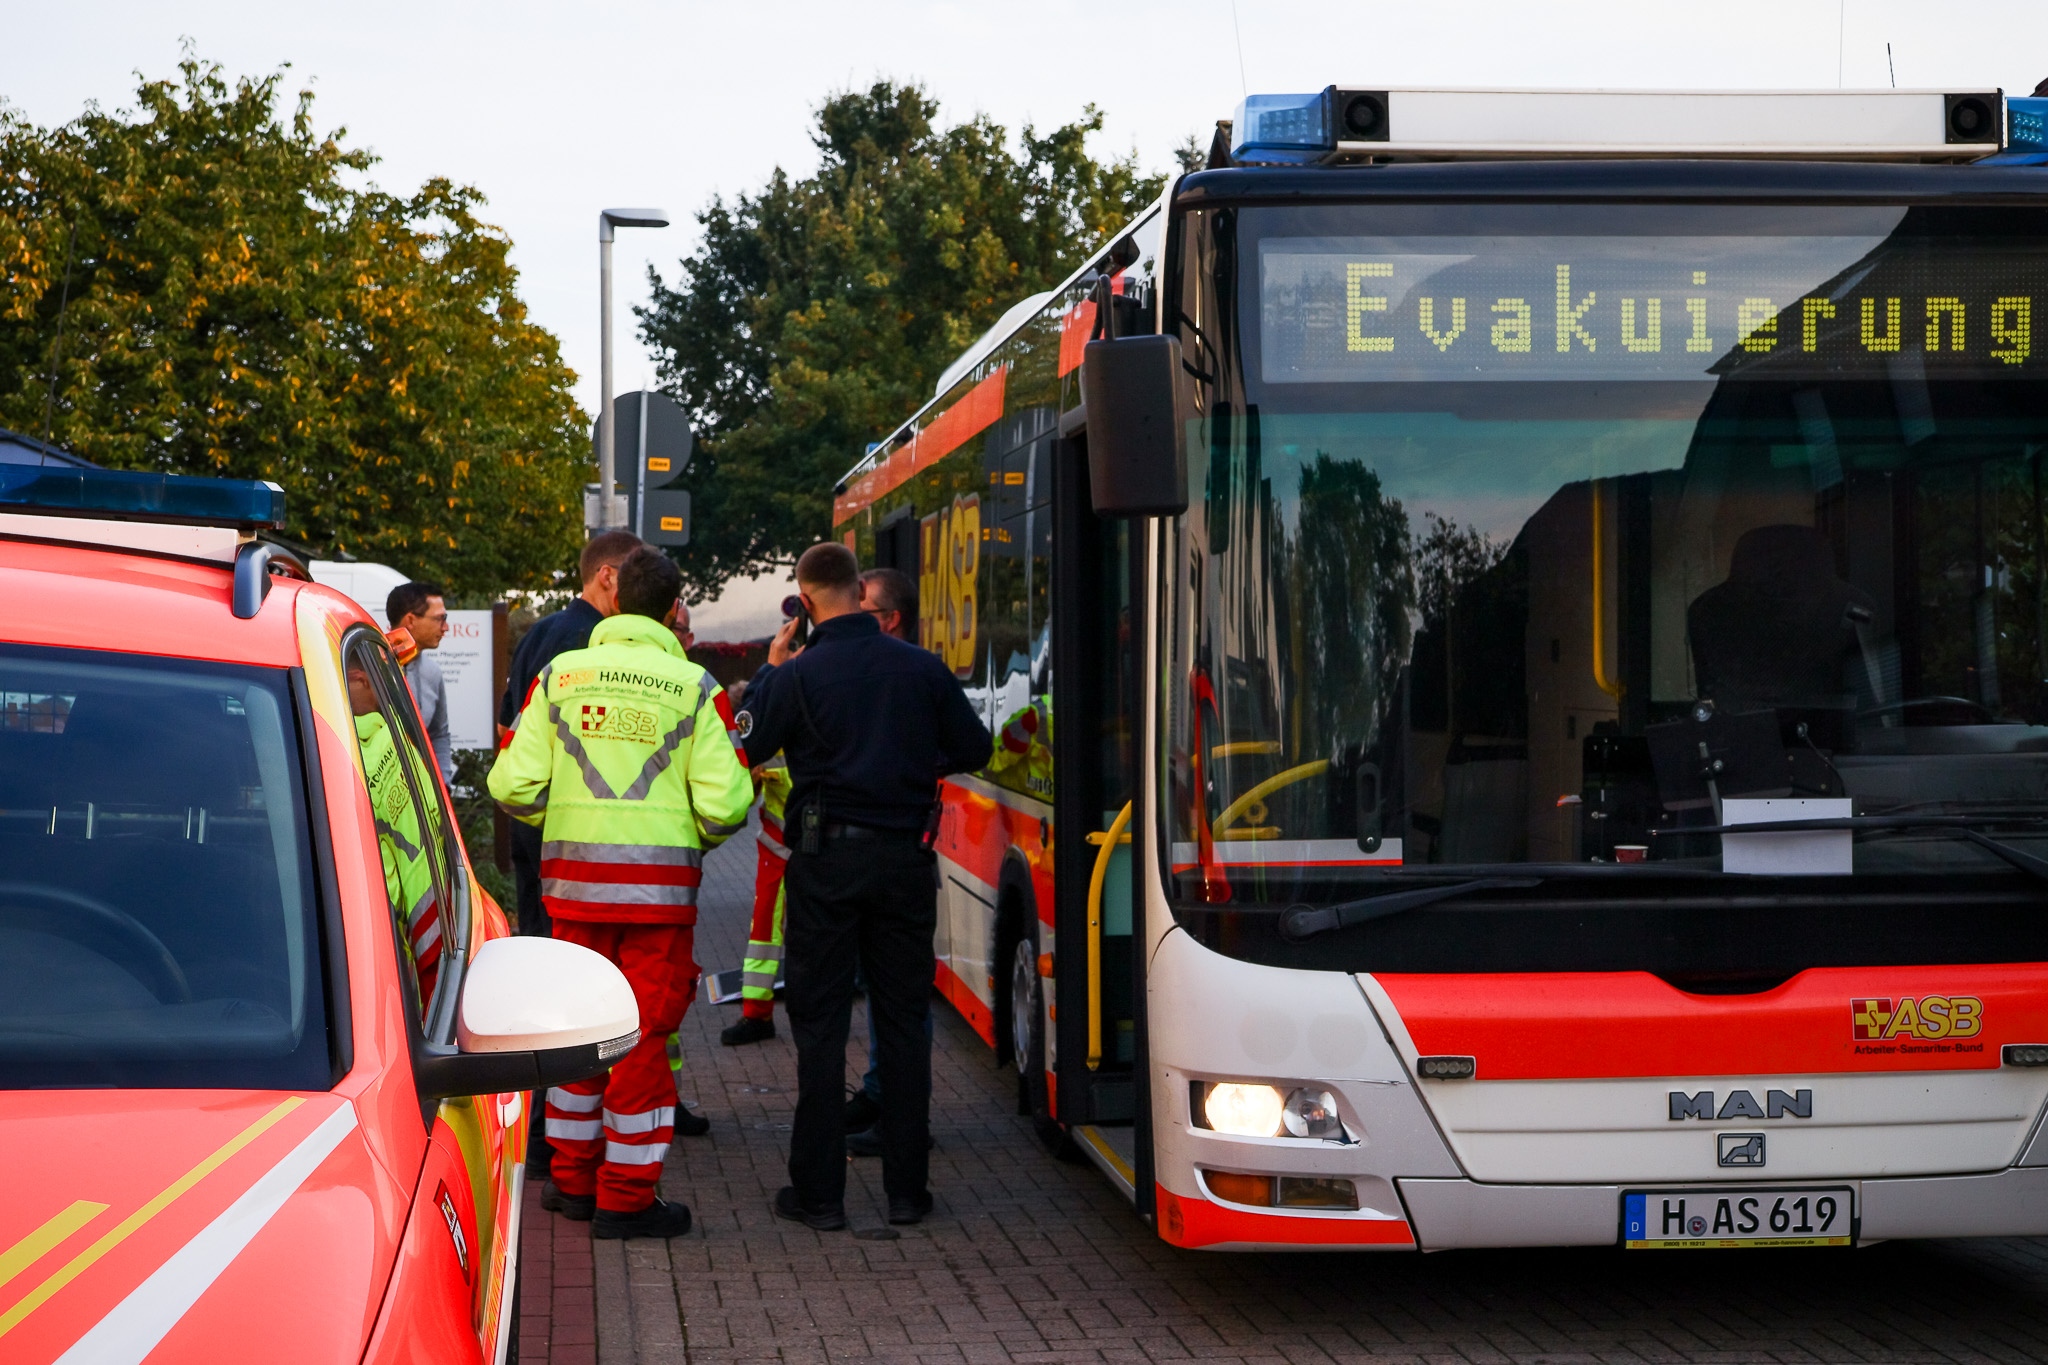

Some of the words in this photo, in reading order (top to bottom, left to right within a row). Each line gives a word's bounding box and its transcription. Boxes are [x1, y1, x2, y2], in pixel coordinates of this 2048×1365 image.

[1346, 263, 2032, 364] Evakuierung
[600, 671, 684, 697] HANNOVER
[598, 706, 659, 737] ASB
[1882, 994, 1984, 1041] ASB
[1854, 1042, 1984, 1055] Arbeiter-Samariter-Bund
[1668, 1088, 1813, 1121] MAN
[1631, 1221, 1640, 1233] D
[1661, 1197, 1686, 1236] H
[1712, 1196, 1760, 1235] AS
[1768, 1195, 1838, 1233] 619
